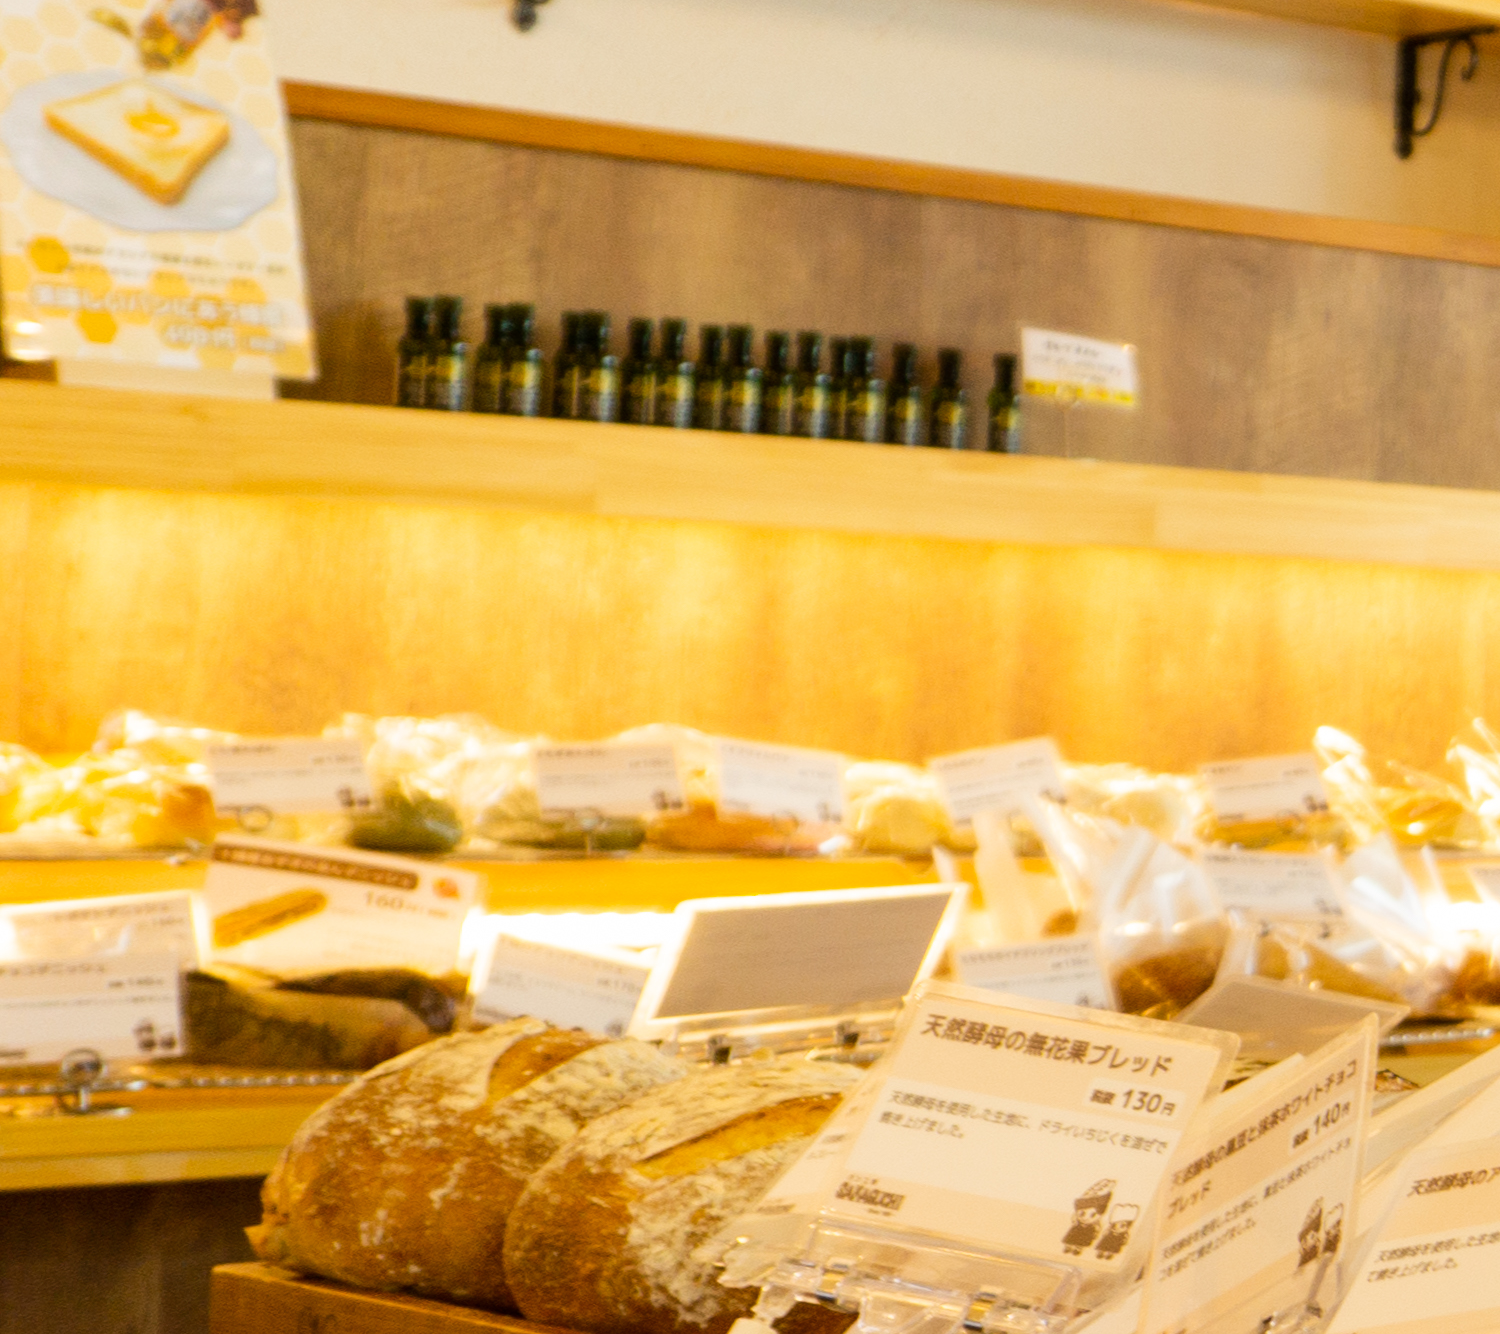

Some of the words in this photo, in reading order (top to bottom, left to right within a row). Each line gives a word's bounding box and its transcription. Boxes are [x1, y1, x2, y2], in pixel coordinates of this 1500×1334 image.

[920, 1013, 1175, 1078] 天然酵母の無花果ブレッド
[1120, 1087, 1178, 1117] 130円
